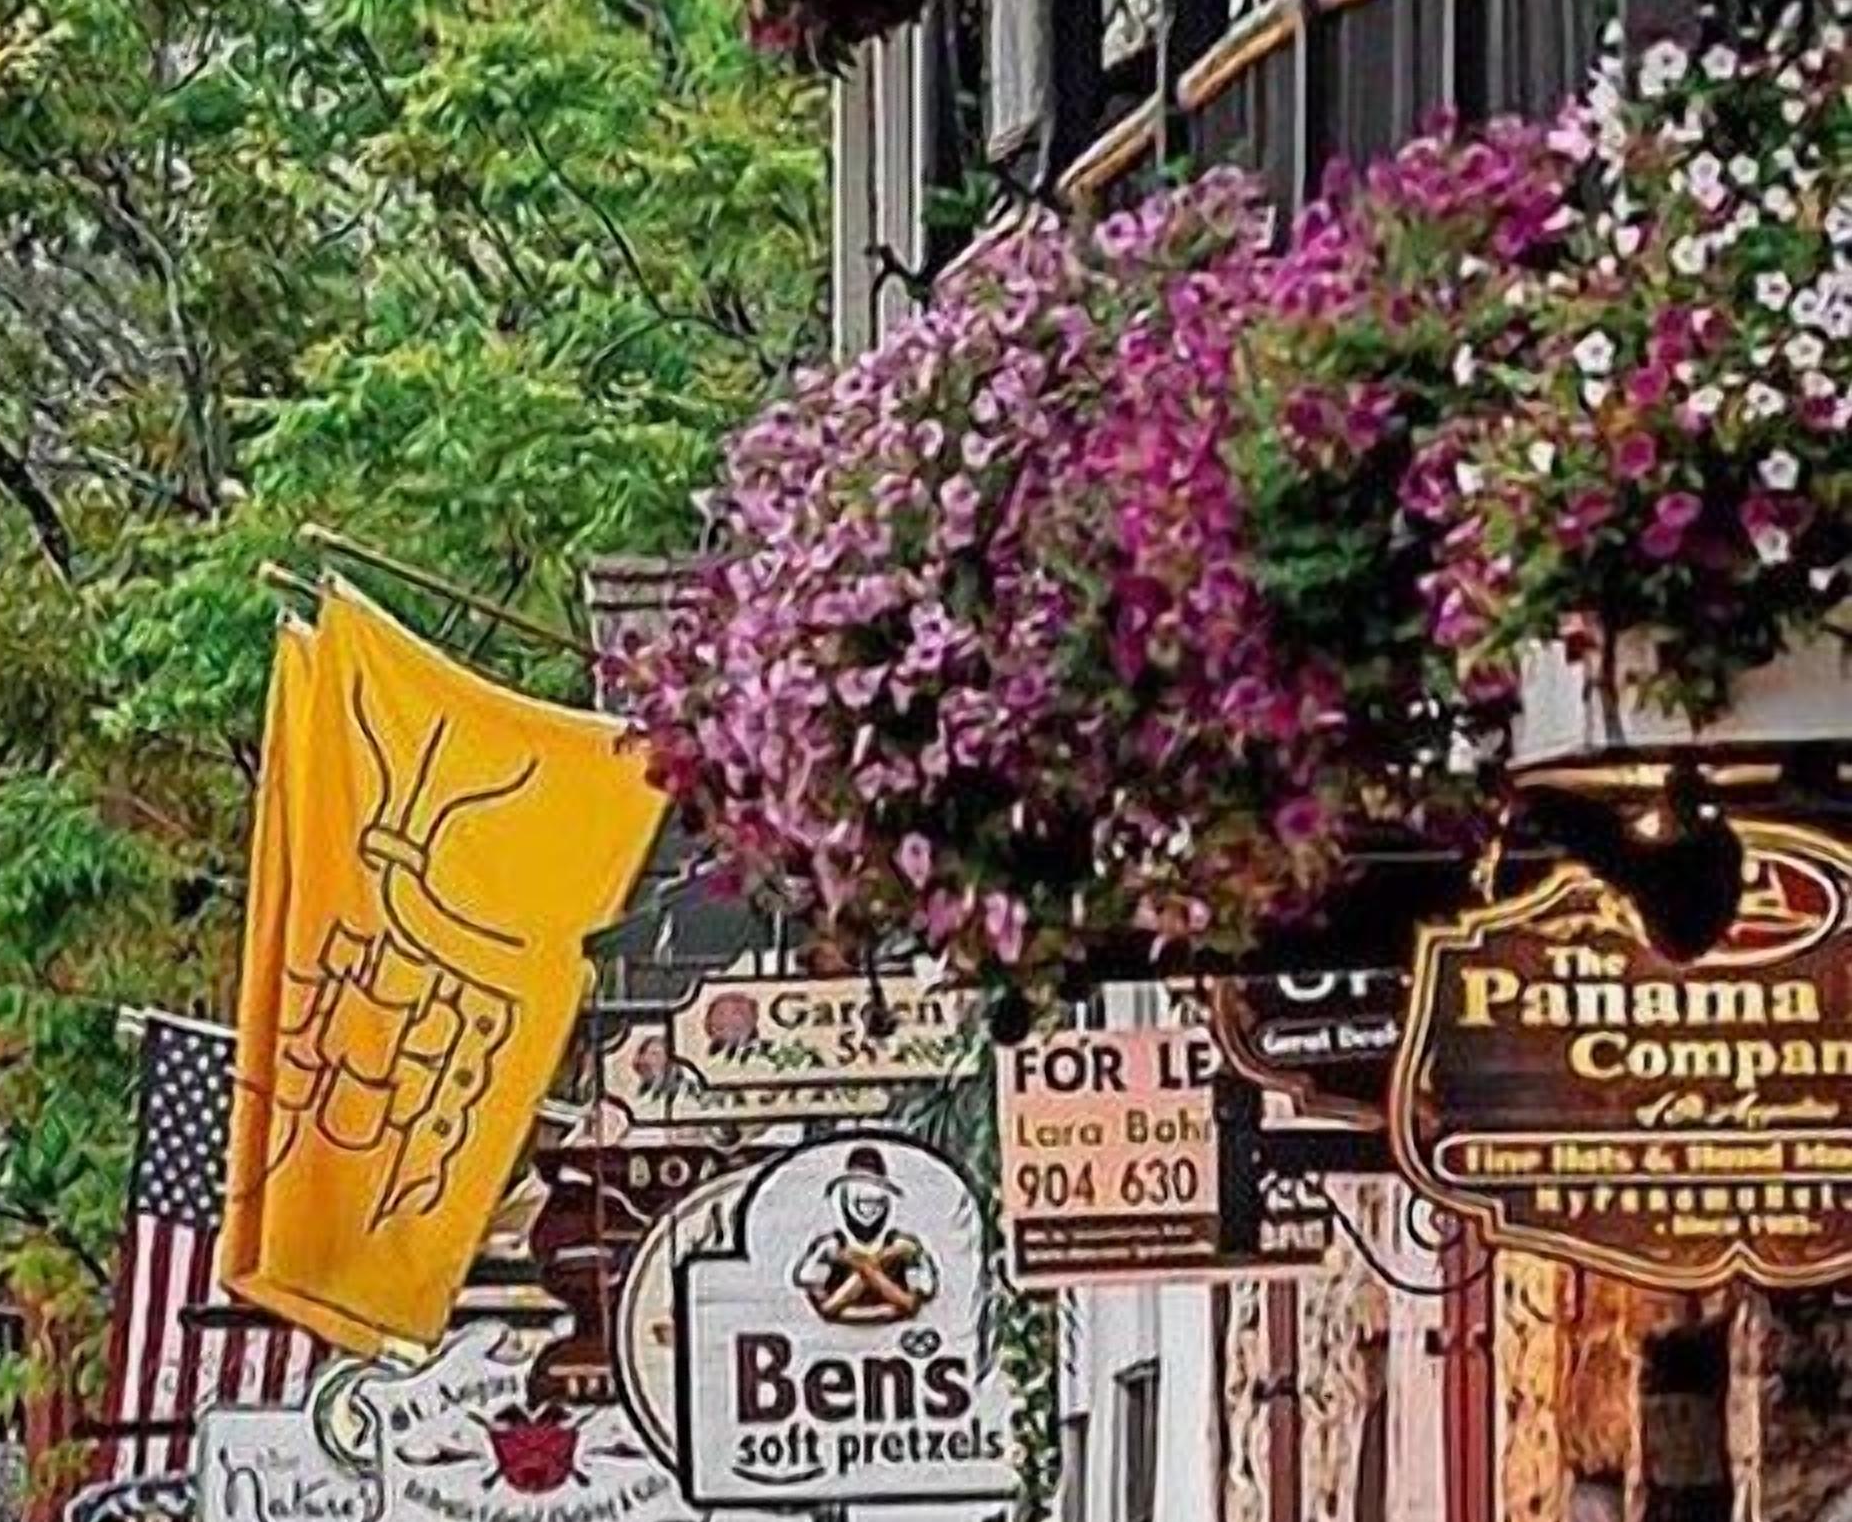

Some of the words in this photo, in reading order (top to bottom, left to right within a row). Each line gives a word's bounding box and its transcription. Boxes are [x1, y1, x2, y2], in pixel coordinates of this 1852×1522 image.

[1546, 946, 1627, 976] The
[1460, 968, 1821, 1028] Panama
[1015, 1045, 1128, 1093] FOR
[1016, 1113, 1103, 1148] Lara
[1016, 1162, 1096, 1209] 904
[1120, 1156, 1199, 1207] 630
[738, 1425, 820, 1466] soft
[837, 1420, 1004, 1475] pretzels
